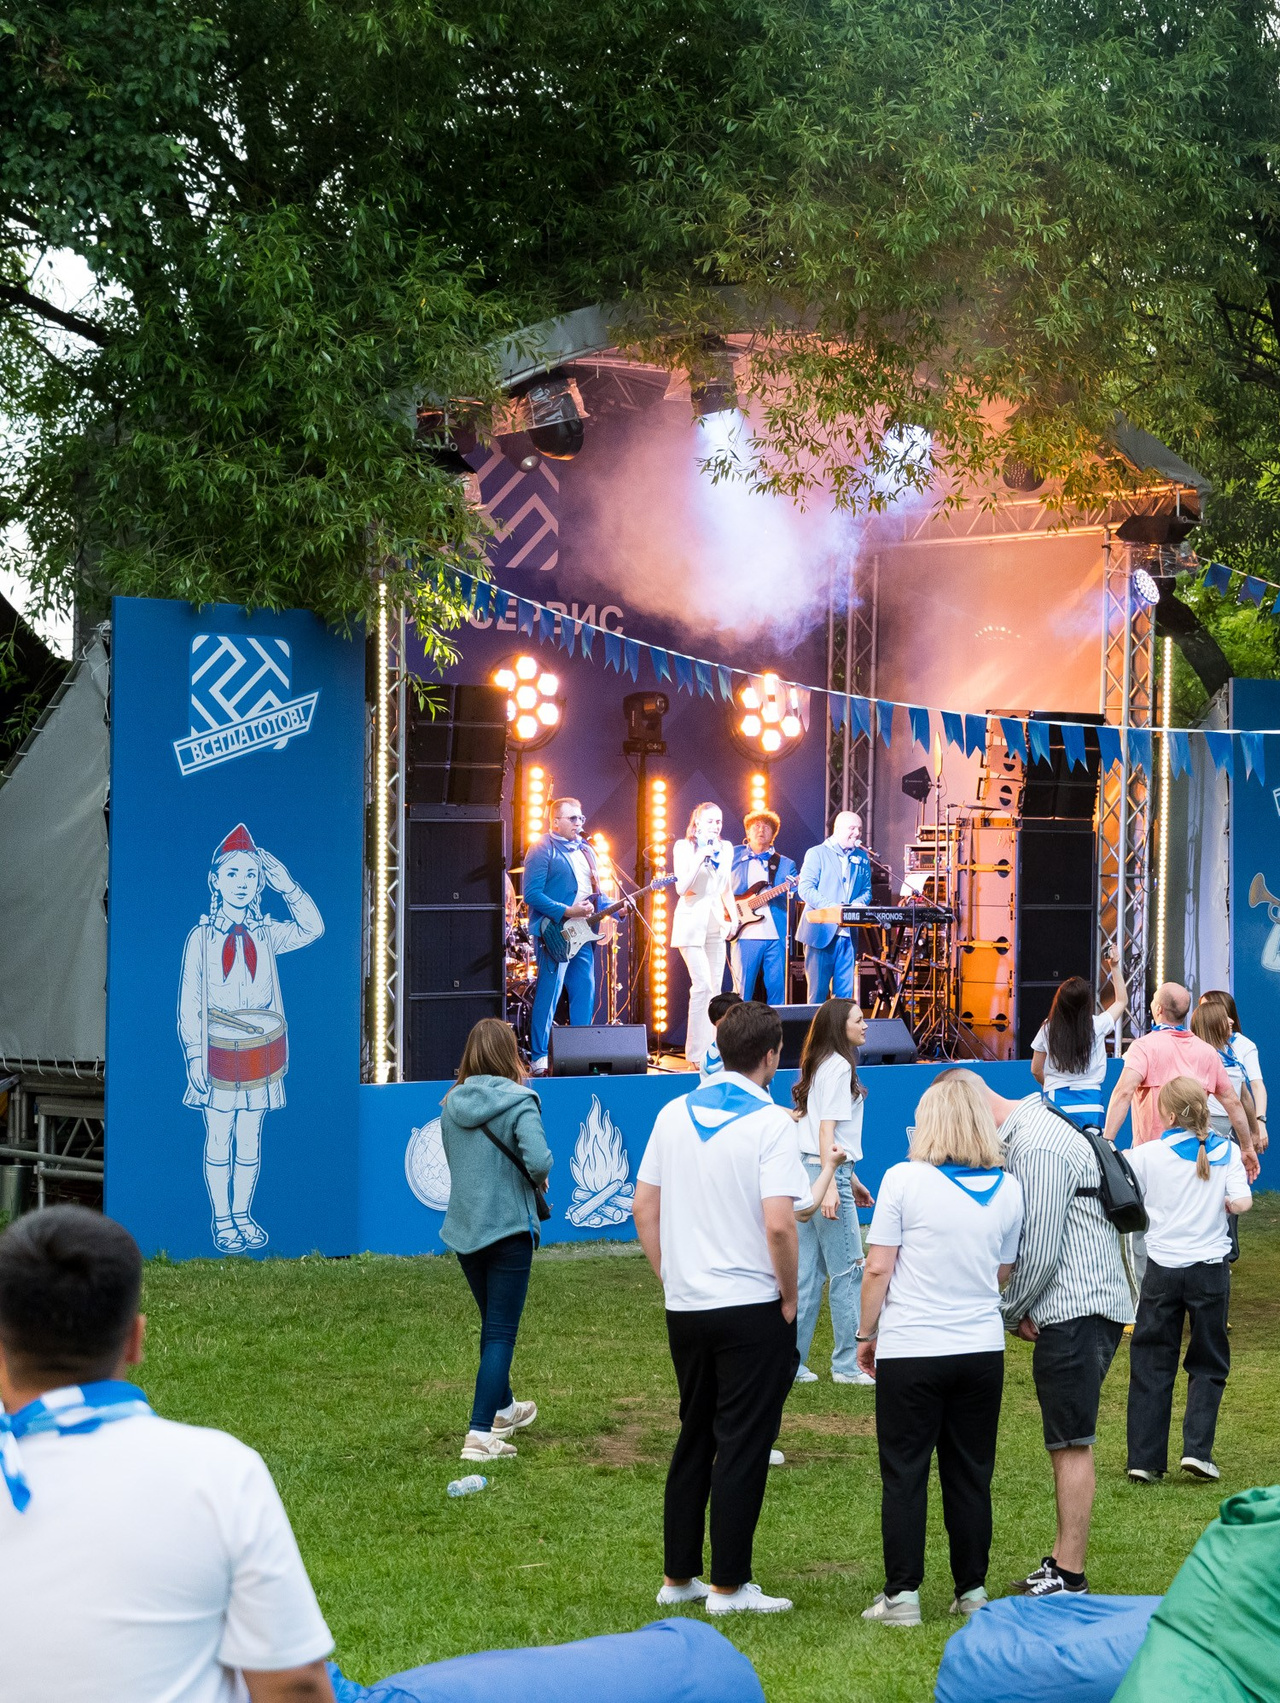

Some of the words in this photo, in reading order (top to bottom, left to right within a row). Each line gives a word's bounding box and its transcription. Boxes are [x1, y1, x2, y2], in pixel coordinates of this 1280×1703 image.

[190, 727, 251, 762] ВСЕГДА
[250, 706, 305, 740] ГОТОВ!
[843, 912, 860, 921] KORG
[877, 912, 903, 921] KRONOS
